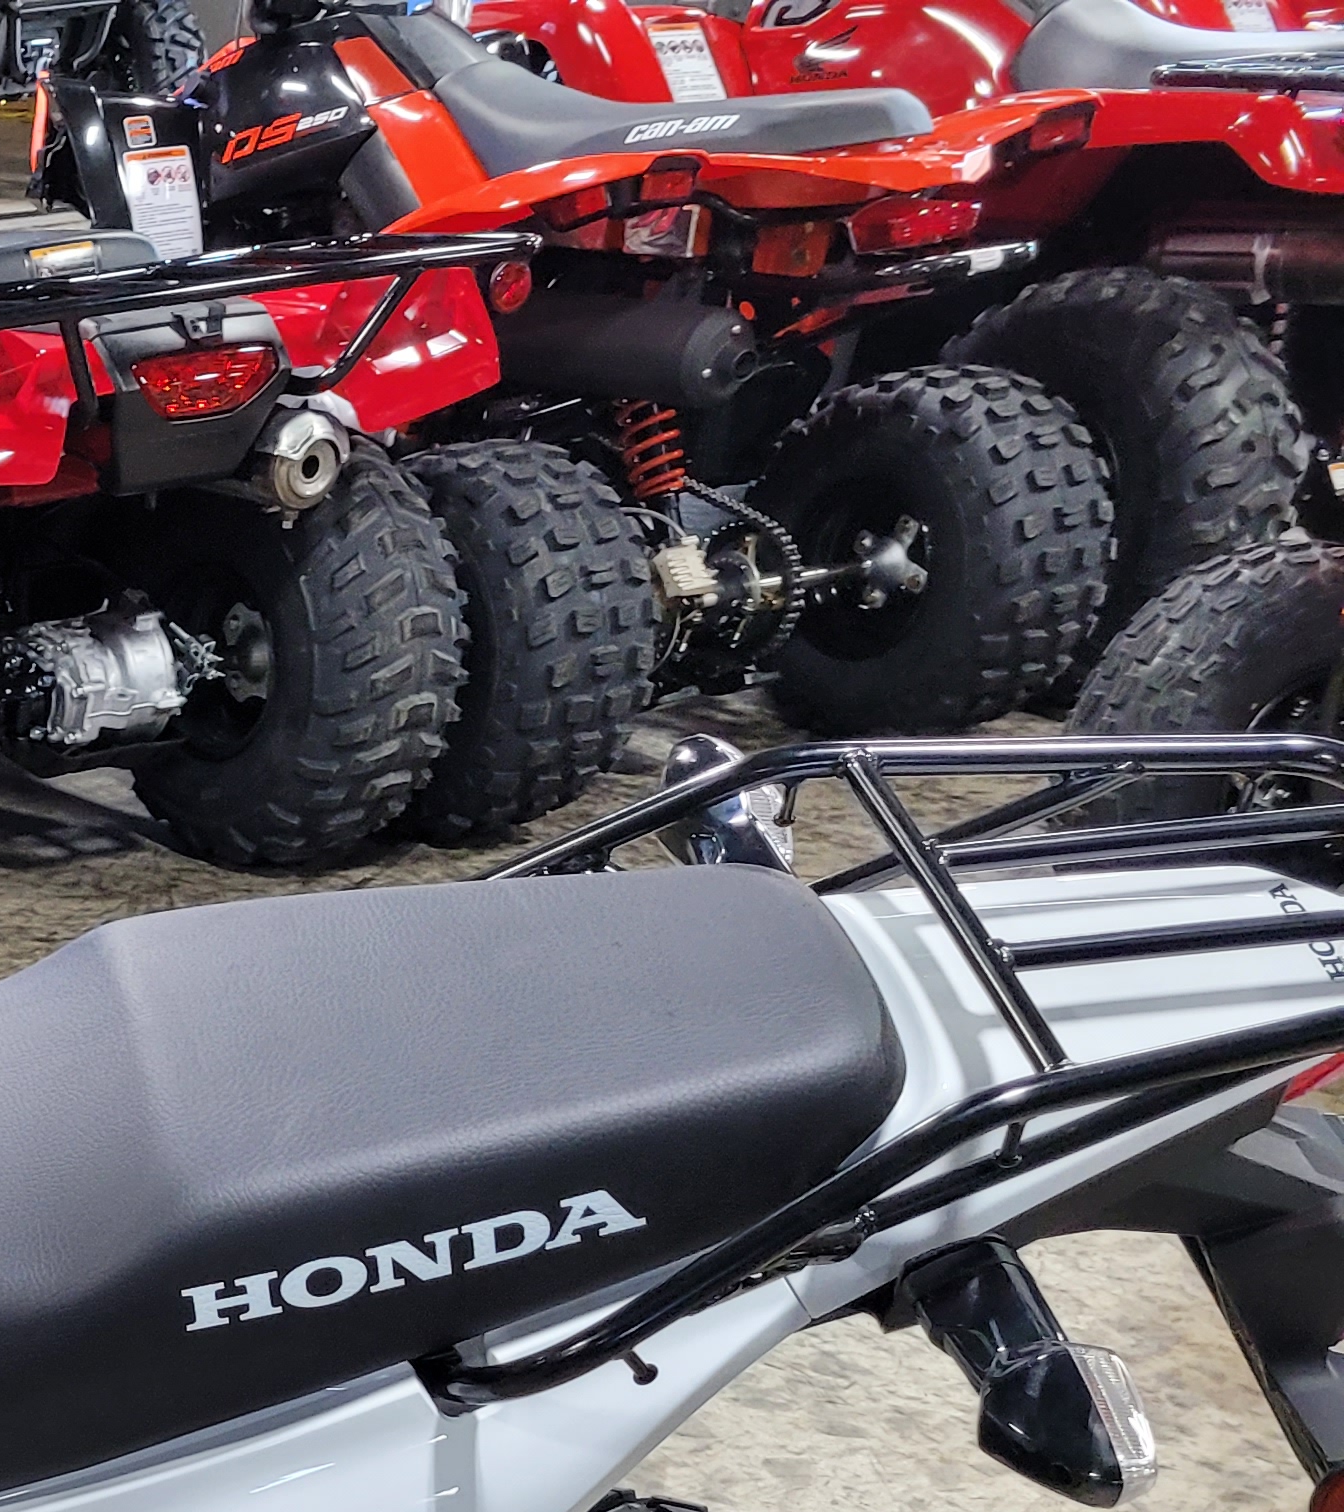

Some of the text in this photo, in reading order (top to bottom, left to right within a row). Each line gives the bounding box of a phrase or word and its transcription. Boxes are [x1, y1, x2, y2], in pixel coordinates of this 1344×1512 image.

[221, 105, 349, 165] DS 250
[623, 114, 741, 145] can-am
[1269, 883, 1344, 981] HODA
[179, 1189, 648, 1332] HONDA
